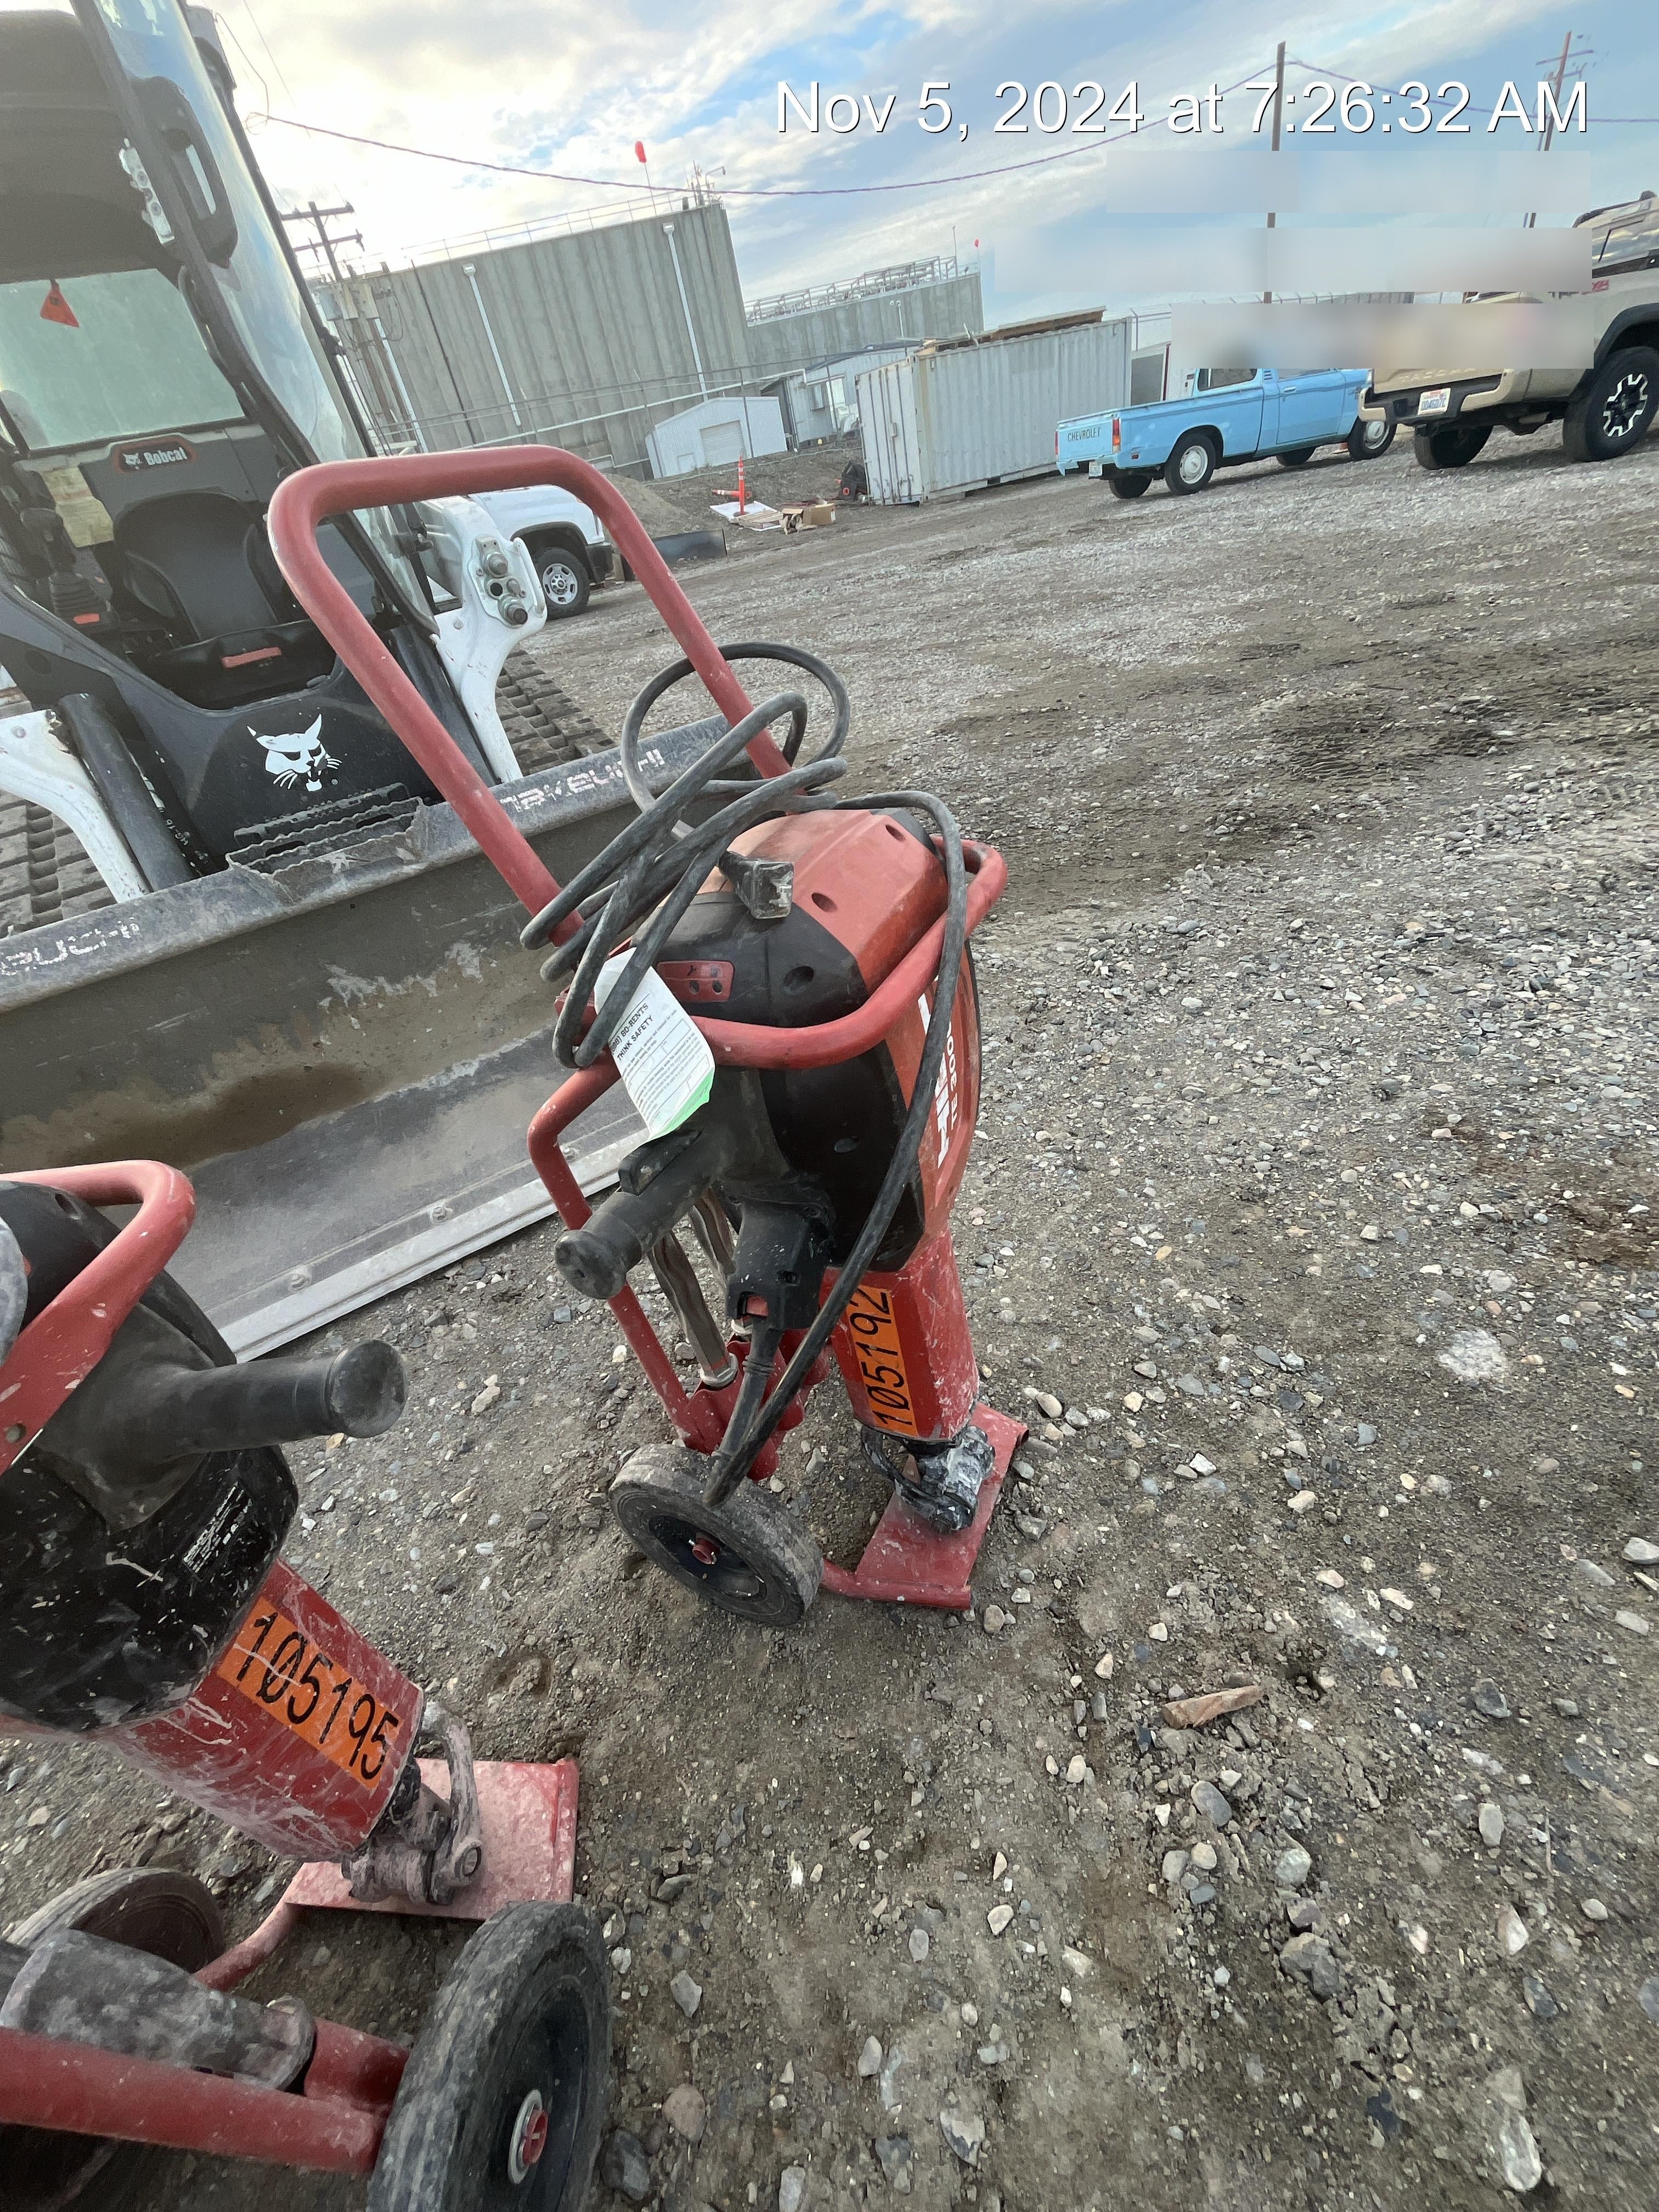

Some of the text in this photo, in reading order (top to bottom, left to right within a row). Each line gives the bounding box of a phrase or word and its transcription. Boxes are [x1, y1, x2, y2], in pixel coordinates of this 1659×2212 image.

[143, 447, 188, 466] Bobcat
[1068, 427, 1101, 442] CHEVROLET
[617, 1040, 633, 1061] THINK
[631, 1014, 653, 1042] SAFETY
[849, 1288, 913, 1426] 105192
[236, 1612, 399, 1780] 105195
